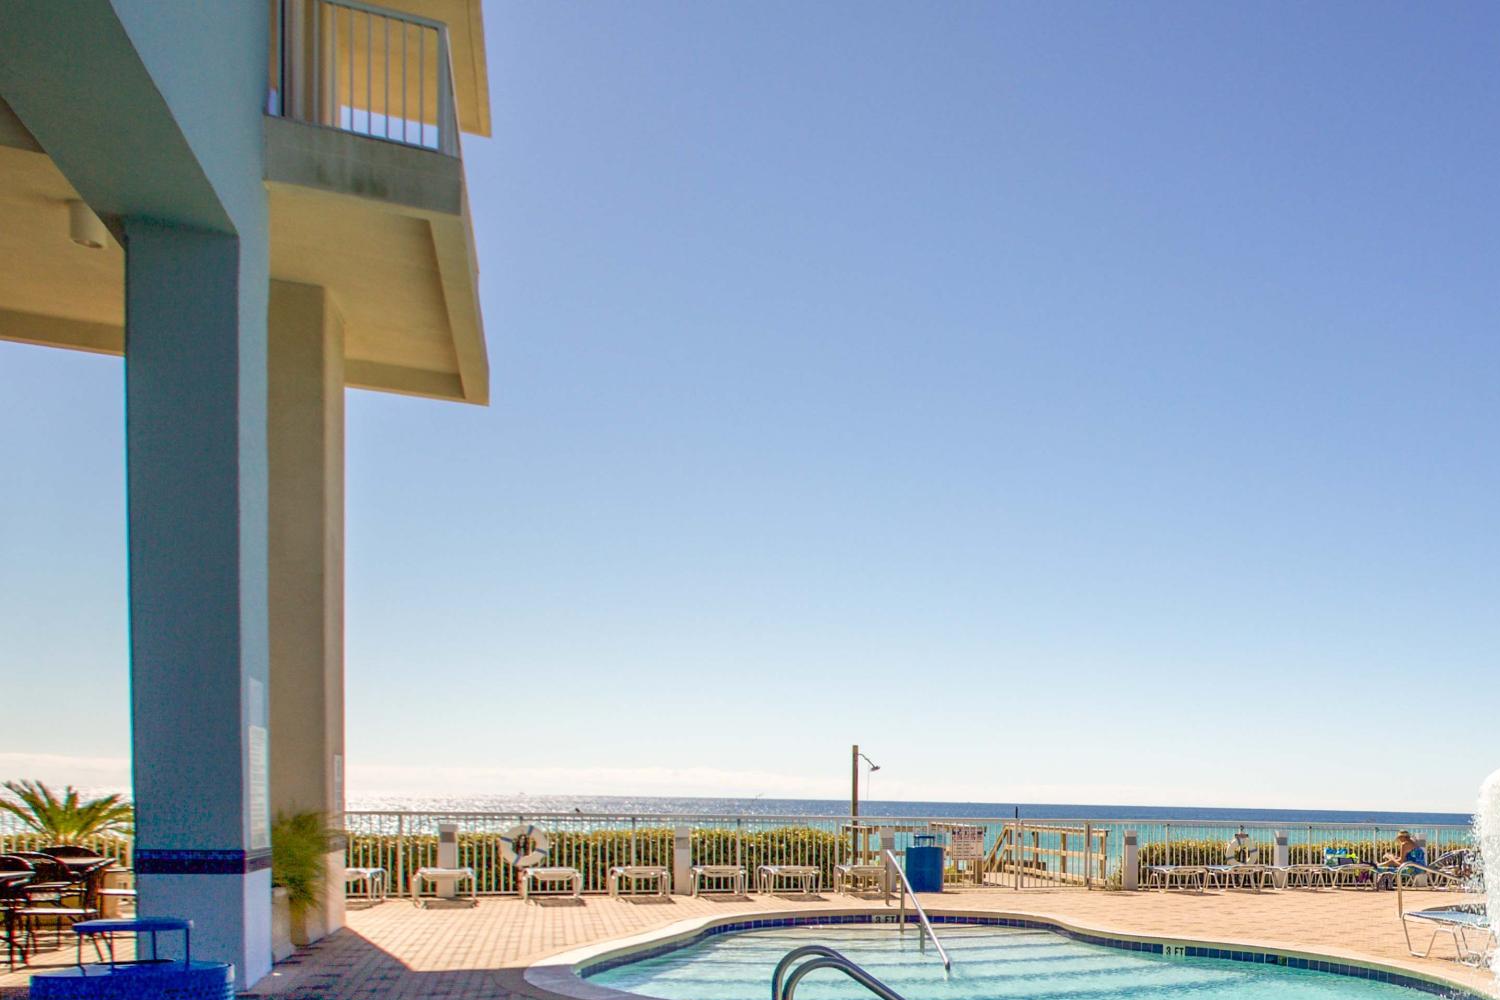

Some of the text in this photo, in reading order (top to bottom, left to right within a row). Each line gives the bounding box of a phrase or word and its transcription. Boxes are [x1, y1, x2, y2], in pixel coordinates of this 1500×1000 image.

[885, 915, 896, 923] FT
[1166, 946, 1185, 956] 3 FT
